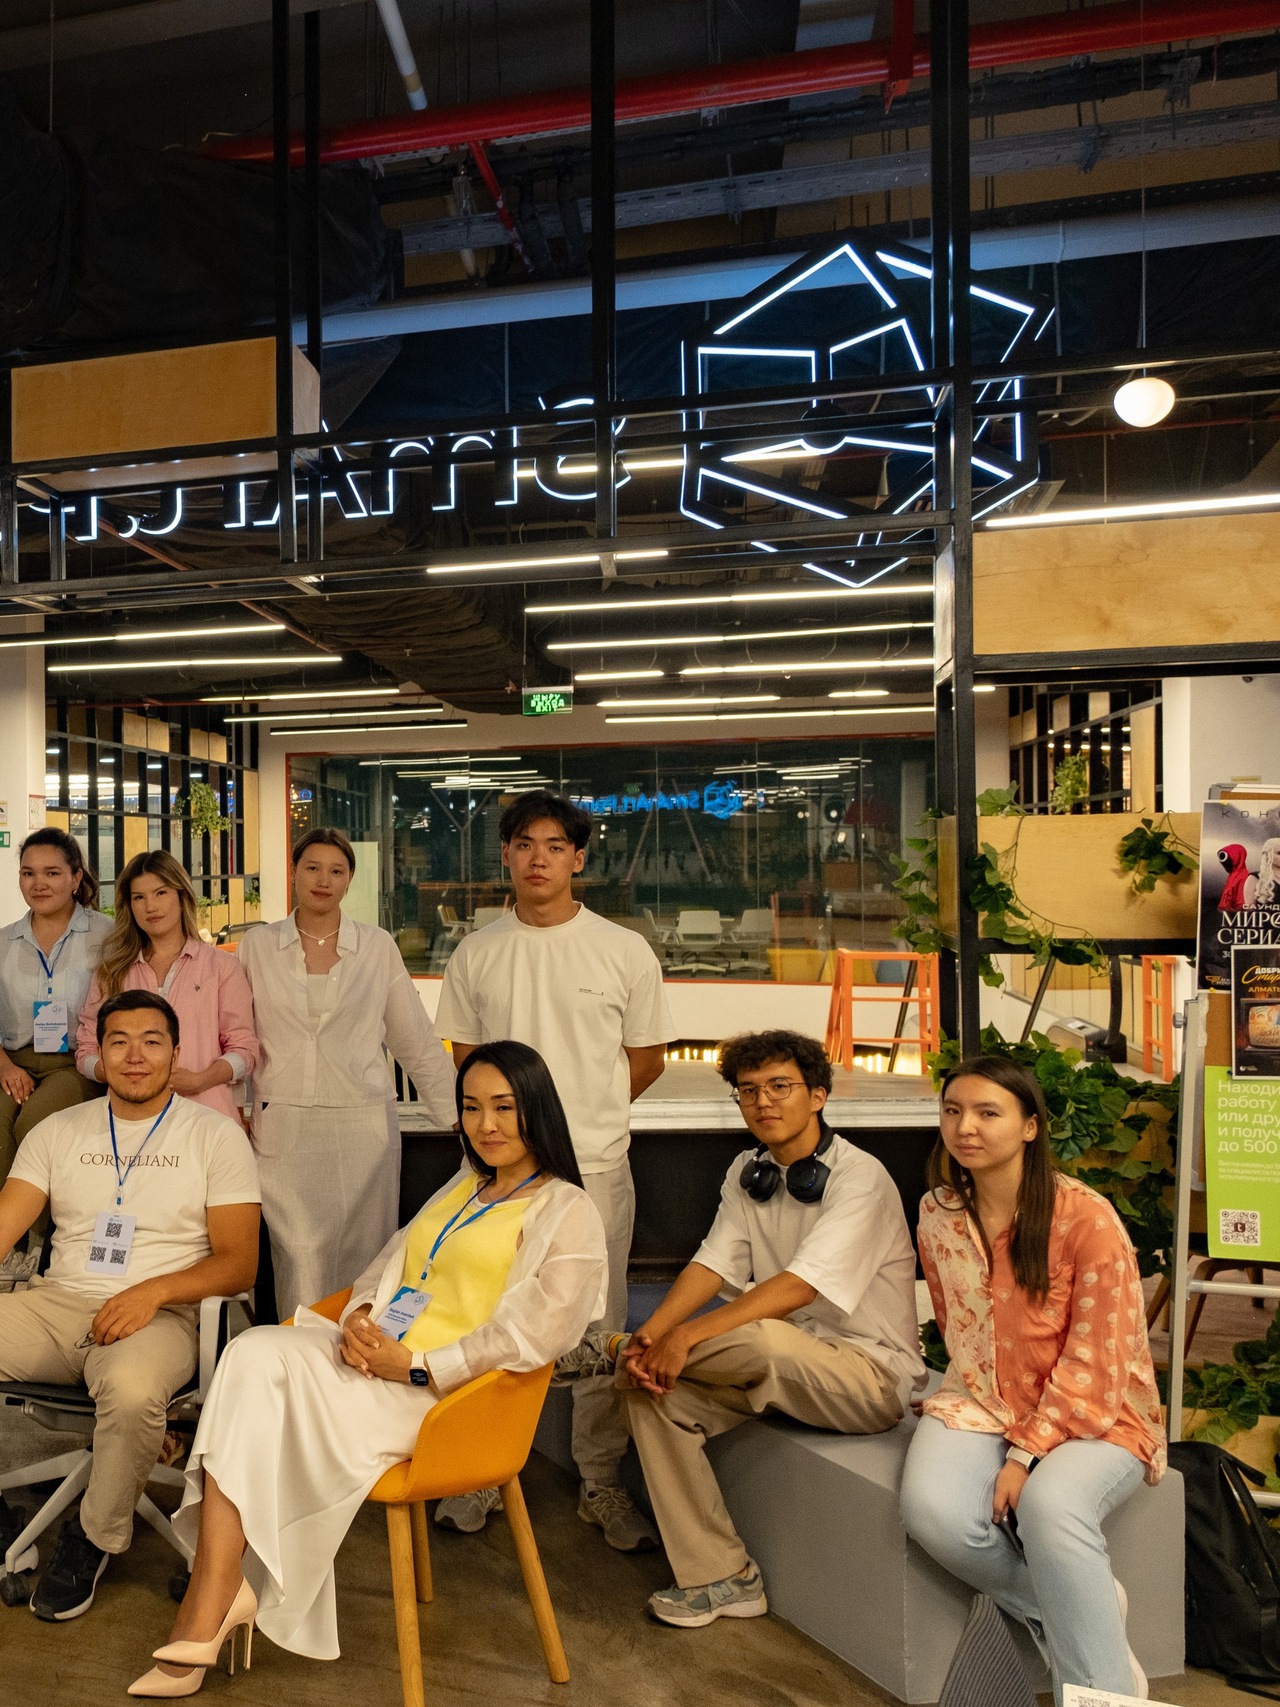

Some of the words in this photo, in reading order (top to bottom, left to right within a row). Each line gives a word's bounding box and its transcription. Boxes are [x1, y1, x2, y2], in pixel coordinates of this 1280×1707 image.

[1221, 810, 1280, 819] КОН
[1218, 1095, 1277, 1112] работу
[1218, 1111, 1248, 1122] или
[1218, 1126, 1228, 1136] и
[1217, 1140, 1239, 1153] до
[1243, 1139, 1278, 1154] 500
[79, 1152, 181, 1168] CORNELIANI
